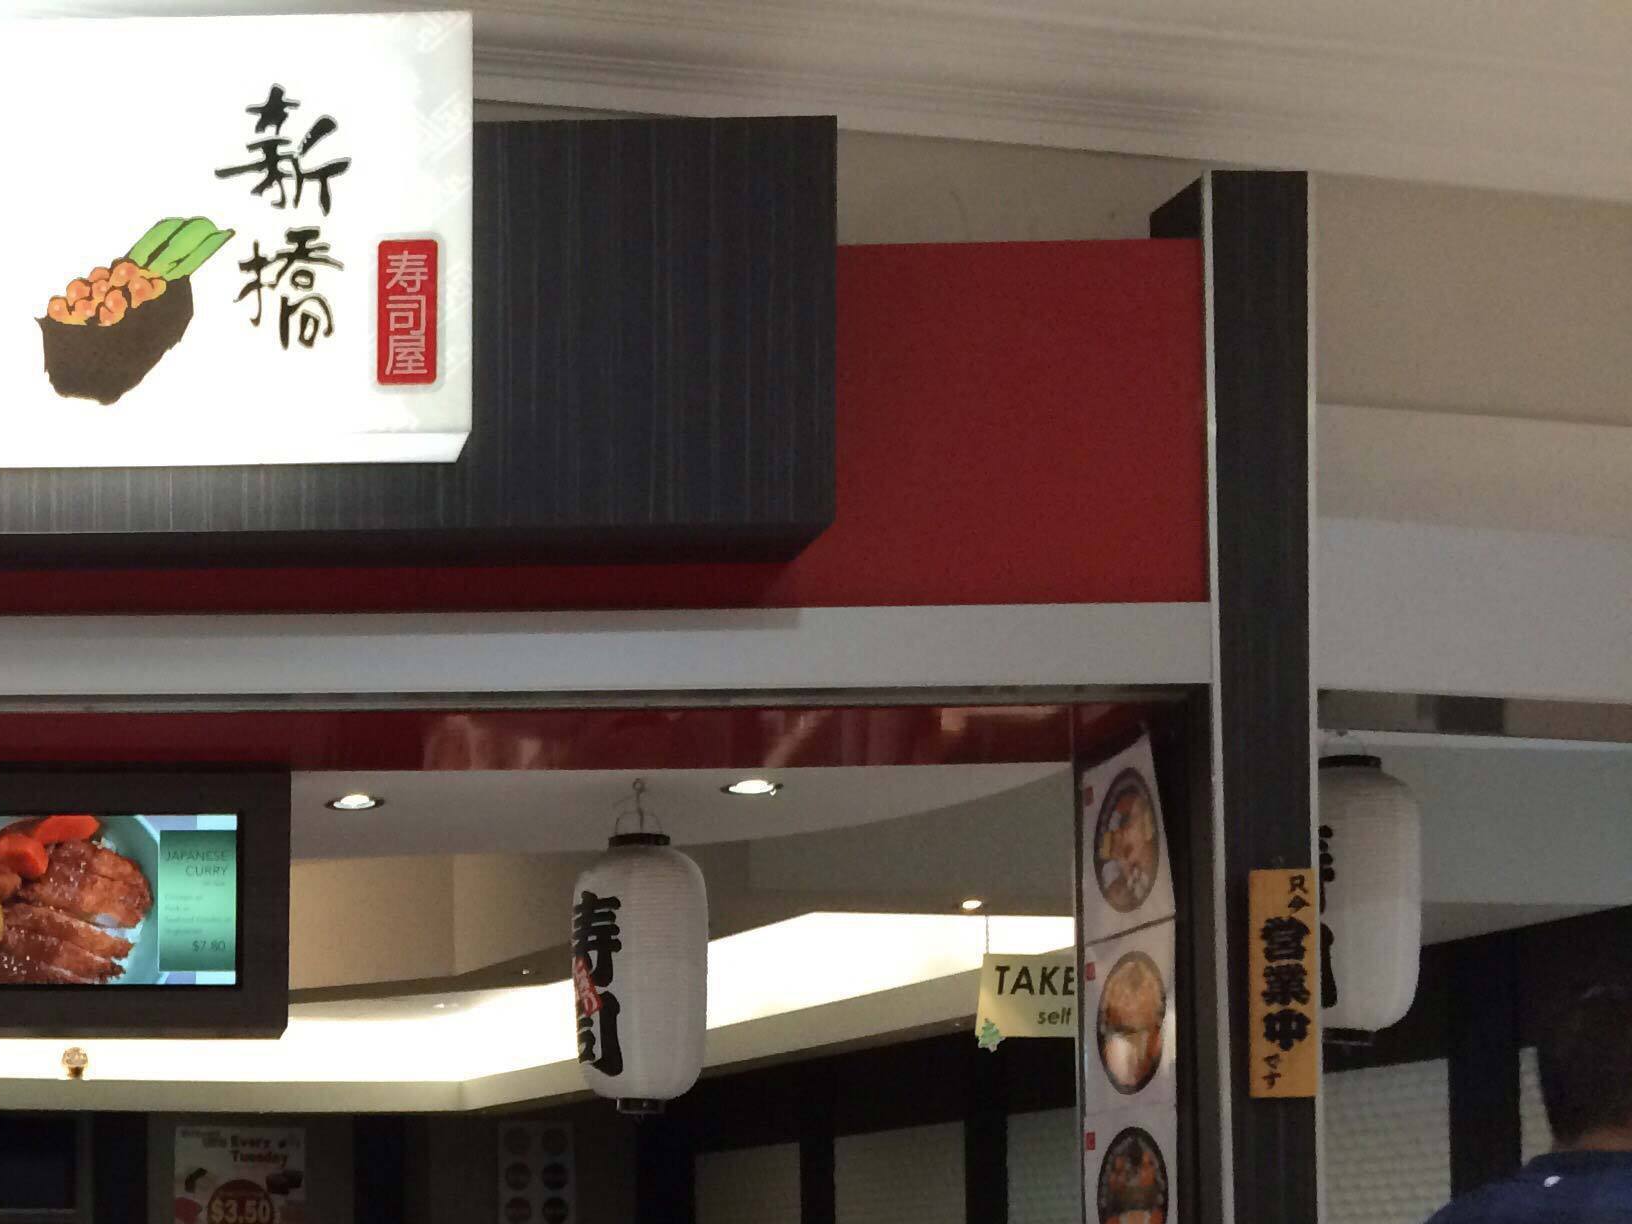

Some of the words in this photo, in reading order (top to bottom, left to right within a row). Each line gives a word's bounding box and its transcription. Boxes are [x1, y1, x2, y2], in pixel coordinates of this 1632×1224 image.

[215, 83, 351, 350] 新橋
[384, 250, 429, 376] 寿司屋
[166, 850, 229, 862] JAPANESE
[185, 865, 228, 877] CURRY
[995, 965, 1075, 996] TAKE
[211, 1199, 272, 1224] $3.50
